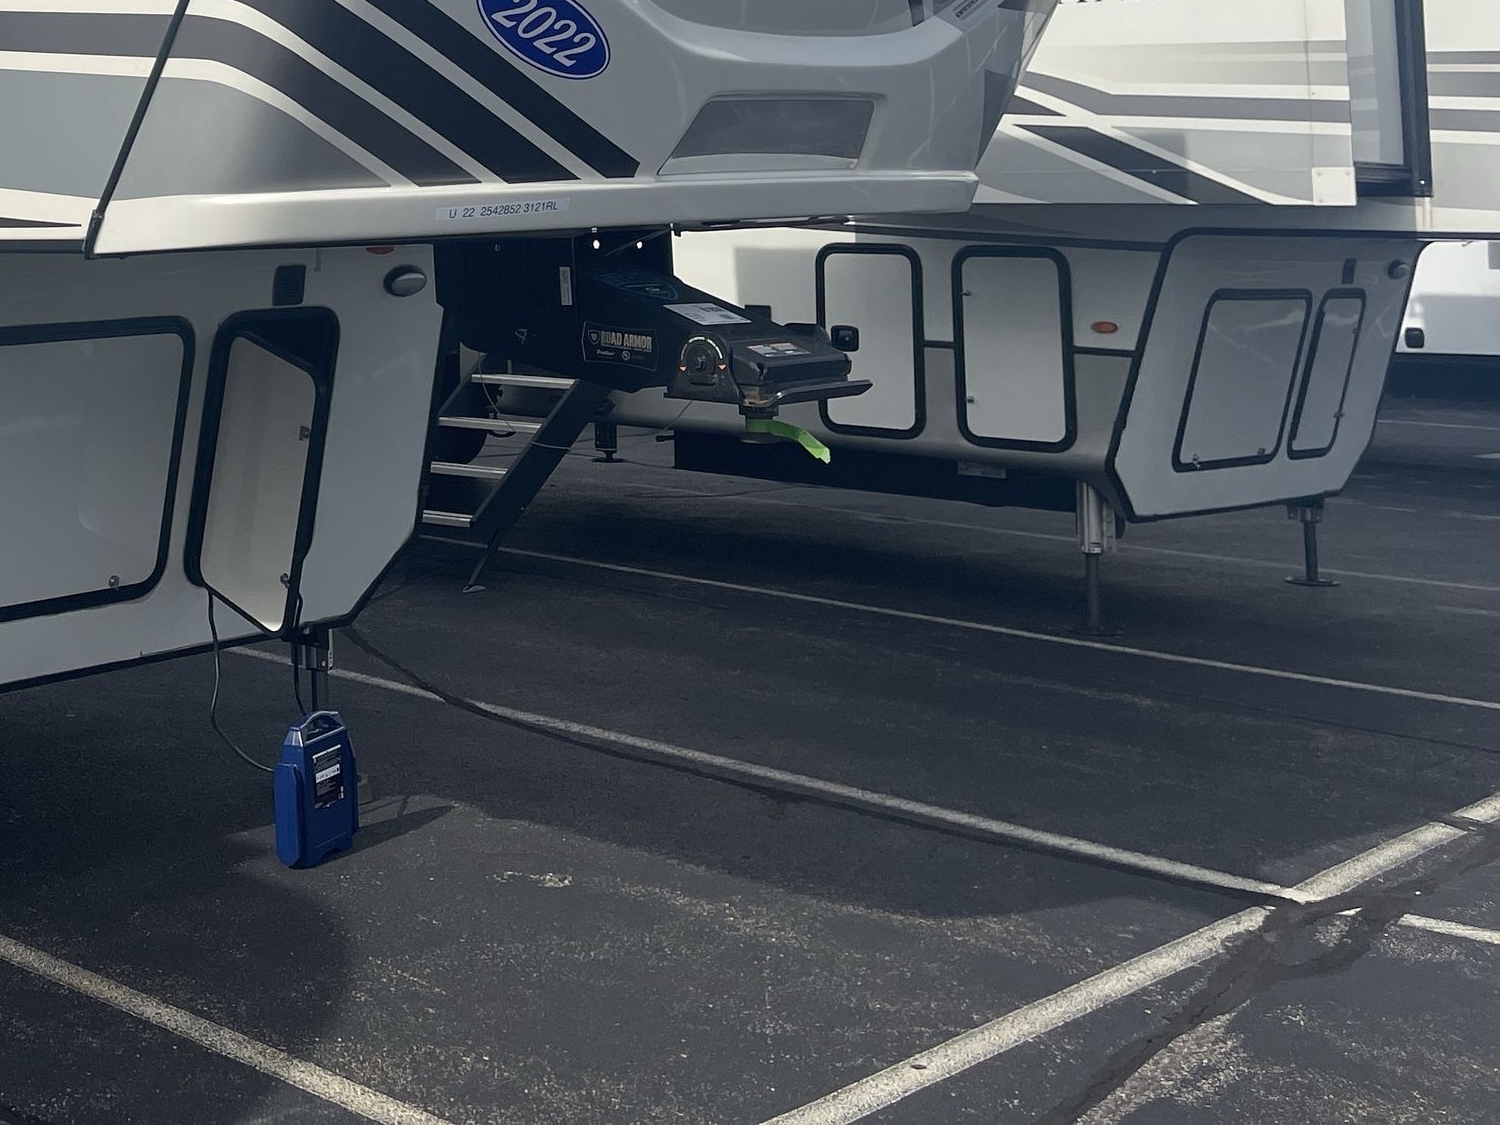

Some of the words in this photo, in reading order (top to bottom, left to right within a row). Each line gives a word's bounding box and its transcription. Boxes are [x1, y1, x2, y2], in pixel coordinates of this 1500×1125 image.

[449, 208, 458, 219] U
[462, 207, 476, 218] 22
[480, 203, 522, 217] 2542852
[523, 201, 559, 213] 3121RL
[601, 331, 622, 346] ROAD
[623, 334, 652, 350] ARMOR
